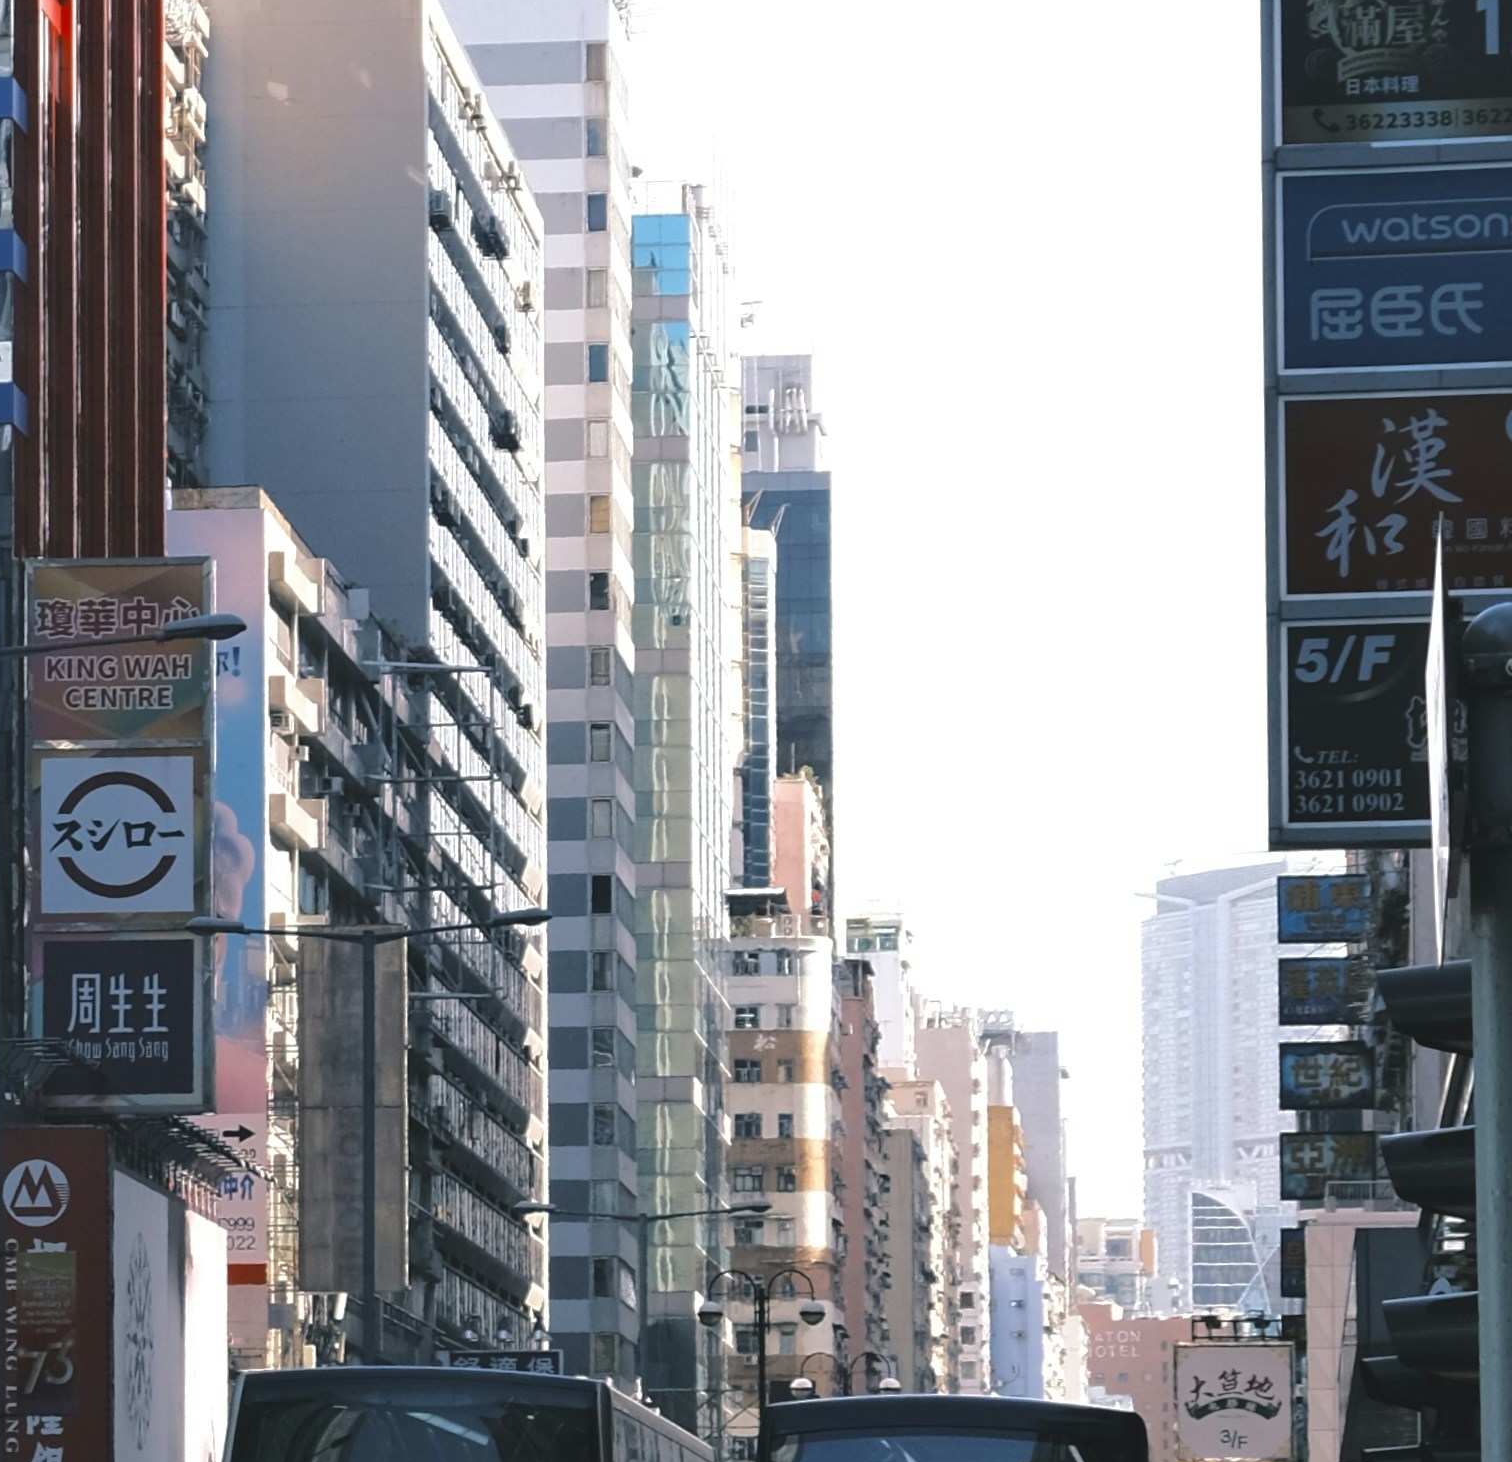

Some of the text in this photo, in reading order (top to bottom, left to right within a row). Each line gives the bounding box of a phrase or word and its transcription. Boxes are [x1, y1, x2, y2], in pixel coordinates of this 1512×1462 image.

[1345, 75, 1419, 96] 日本料理
[1345, 110, 1453, 131] 36223338
[1310, 281, 1484, 341] 屈臣氏
[44, 654, 192, 682] KING WAH
[1294, 634, 1396, 684] 5/F
[63, 685, 174, 711] CENTRE
[1316, 749, 1360, 764] TEL:
[1295, 768, 1404, 789] 3621 0901
[1295, 792, 1405, 814] 3621 0902
[50, 817, 186, 853] スシロー
[67, 973, 169, 1035] 周生生
[138, 1037, 169, 1063] Sang
[5, 1305, 20, 1371] WING
[5, 1385, 20, 1453] LUNG
[1220, 1429, 1249, 1449] 3/F
